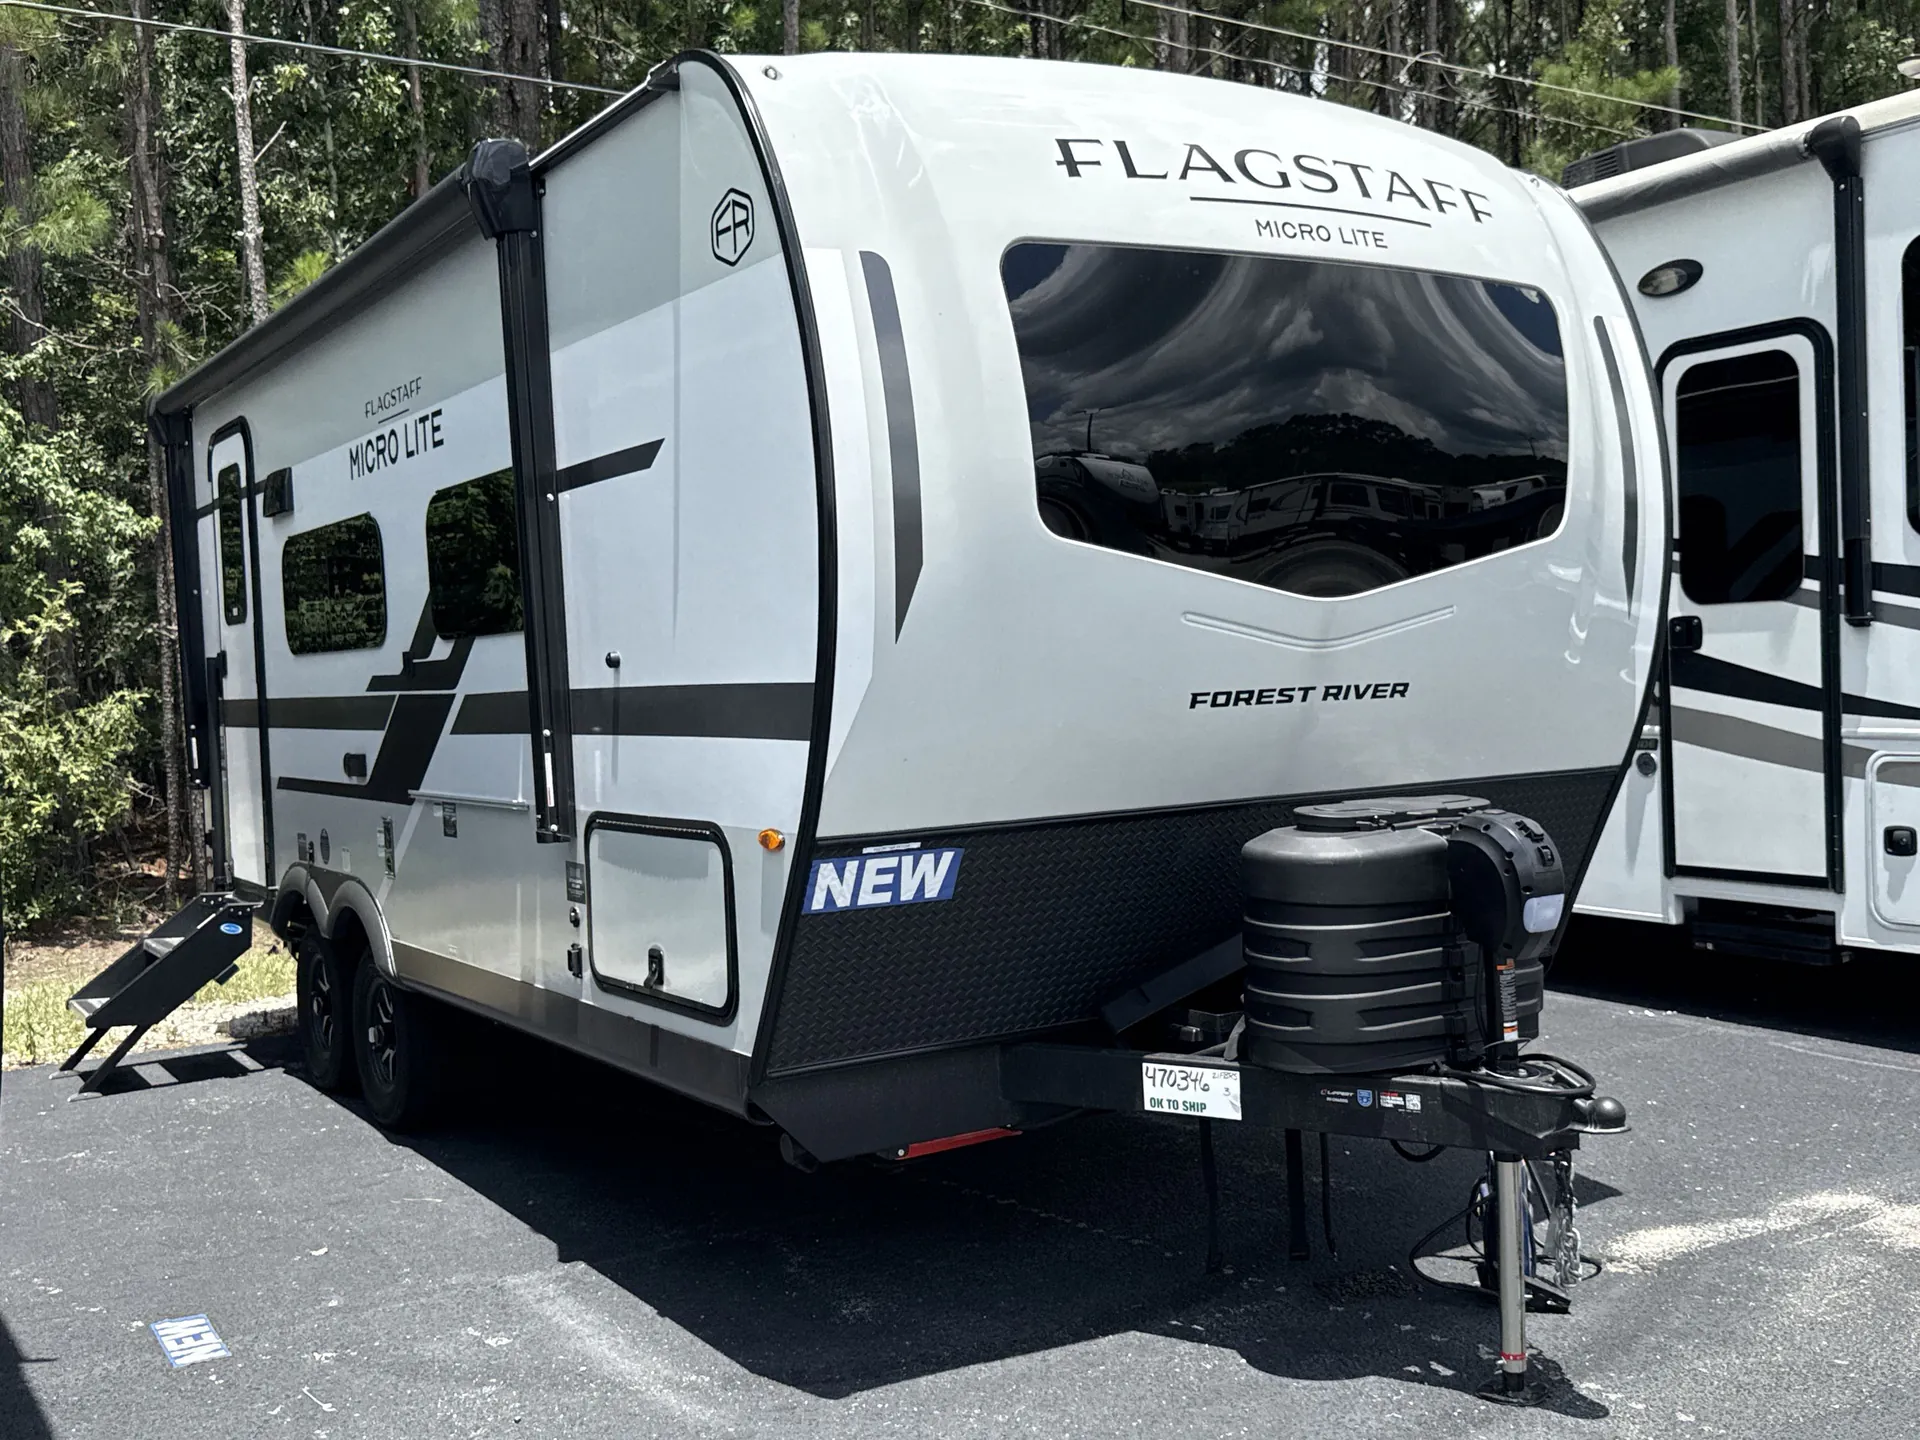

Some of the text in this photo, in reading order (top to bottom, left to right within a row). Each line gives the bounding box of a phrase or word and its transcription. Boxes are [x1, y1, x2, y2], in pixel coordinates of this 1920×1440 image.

[1055, 138, 1493, 223] FLAGSTAFF
[1255, 219, 1389, 249] MICRO LITE
[365, 376, 422, 419] FLAGSTAFF
[349, 408, 444, 481] MICRO LITE
[1189, 682, 1410, 709] FOREST RIVER
[811, 851, 956, 911] NEW
[1145, 1066, 1210, 1092] 470346
[1150, 1097, 1207, 1112] OK TO SHIP
